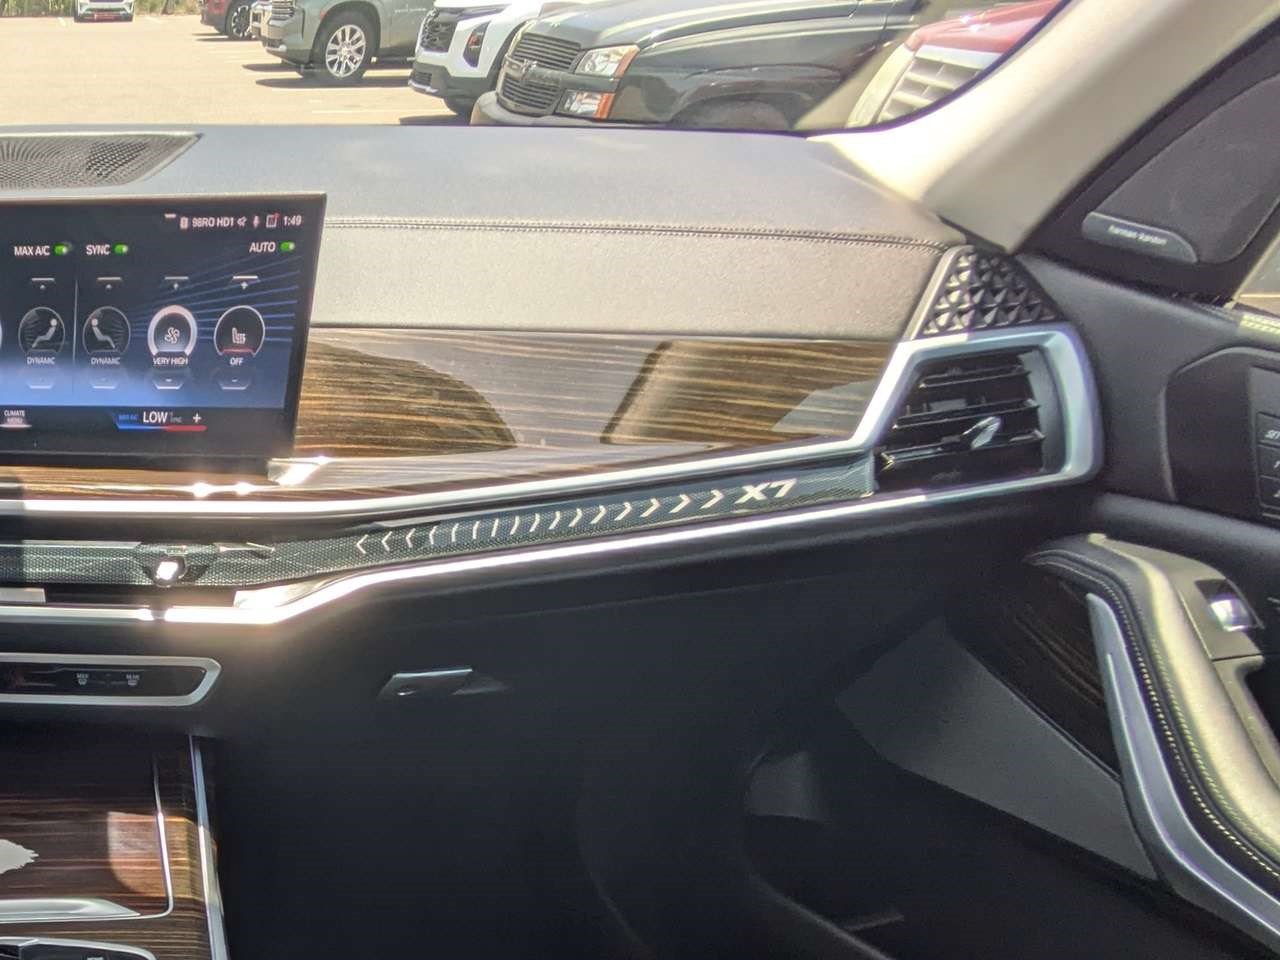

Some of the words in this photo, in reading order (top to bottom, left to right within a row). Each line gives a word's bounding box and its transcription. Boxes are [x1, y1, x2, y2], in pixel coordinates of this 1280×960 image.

[283, 215, 302, 226] 1:49
[14, 246, 34, 256] MAX
[35, 245, 50, 256] A/C
[86, 244, 110, 255] SYNC
[249, 241, 276, 252] AUTO
[27, 357, 55, 365] DYNAMIC
[91, 357, 120, 365] DYNAMIC
[153, 357, 169, 365] VERY
[170, 357, 188, 365] HIGH
[230, 358, 243, 366] OFF
[143, 411, 168, 423] LOW
[734, 478, 797, 504] X7
